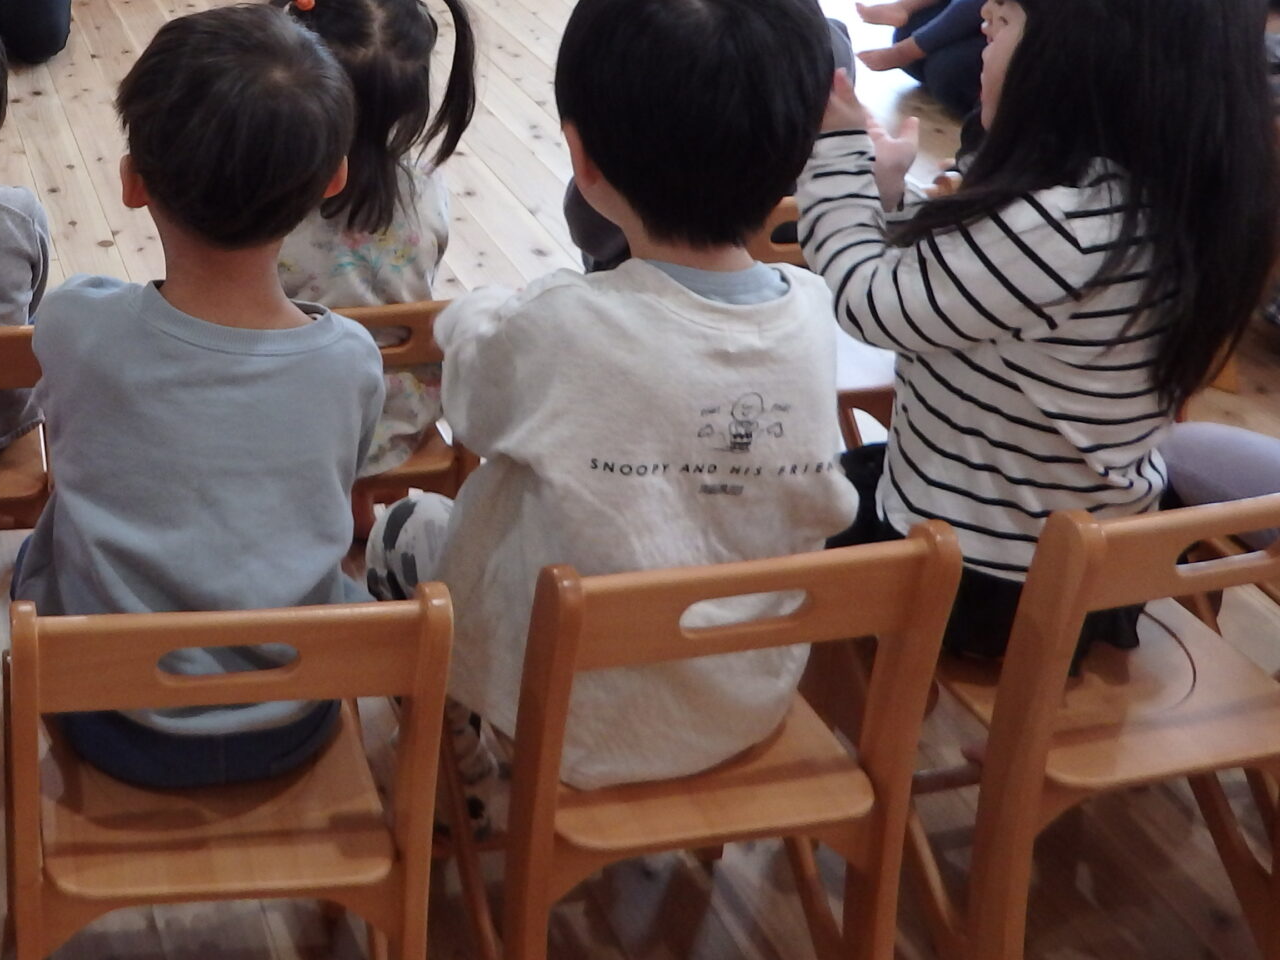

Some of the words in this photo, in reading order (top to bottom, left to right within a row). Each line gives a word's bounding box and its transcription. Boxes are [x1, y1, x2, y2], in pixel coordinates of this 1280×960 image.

[590, 458, 671, 477] SNOOPY
[679, 463, 718, 475] AND
[729, 465, 762, 477] HIS
